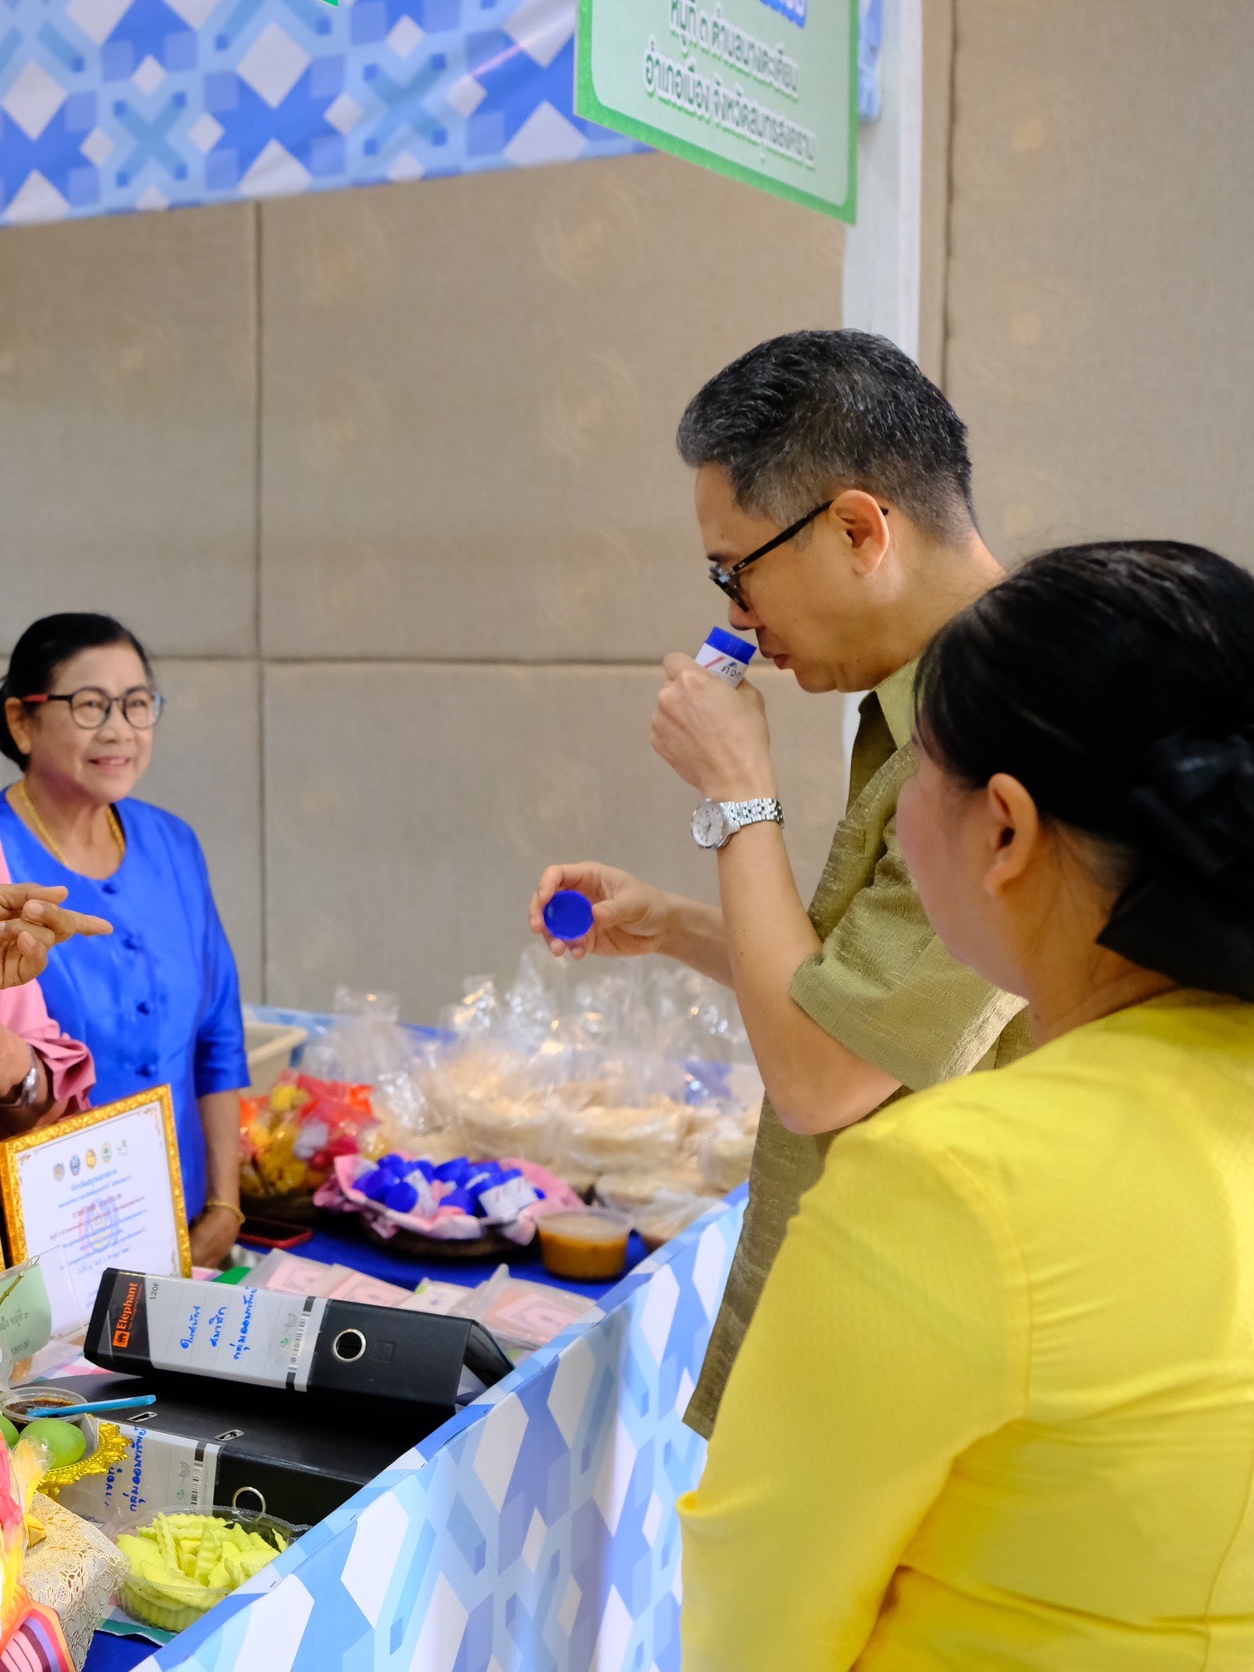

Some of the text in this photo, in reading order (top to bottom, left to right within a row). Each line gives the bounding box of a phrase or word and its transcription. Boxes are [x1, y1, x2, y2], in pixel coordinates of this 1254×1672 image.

[116, 1282, 138, 1330] Elephant
[150, 1282, 160, 1300] 120F
[208, 1306, 227, 1348] สมาชิก
